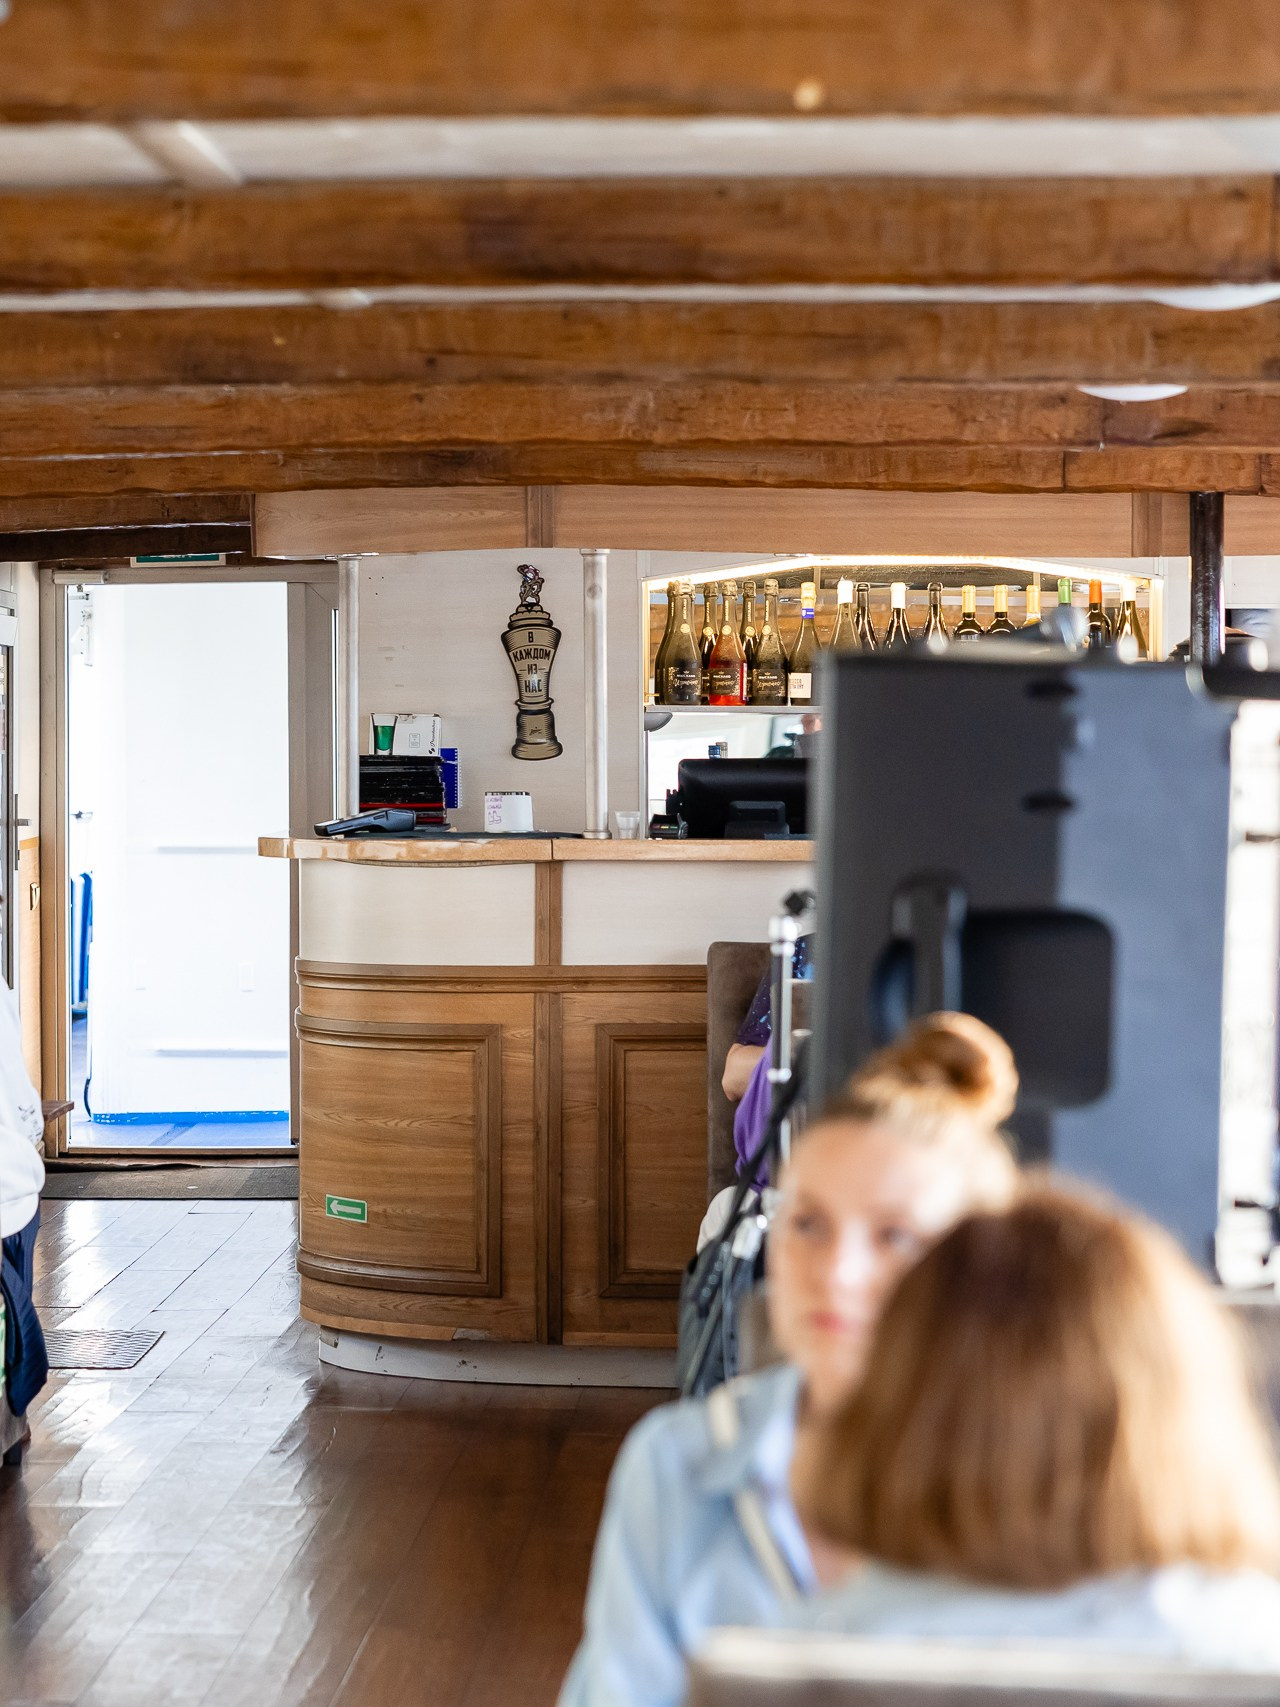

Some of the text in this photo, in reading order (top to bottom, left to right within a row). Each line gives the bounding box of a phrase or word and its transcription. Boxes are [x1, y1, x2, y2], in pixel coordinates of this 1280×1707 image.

[528, 631, 534, 643] В
[512, 648, 551, 662] КАЖДОМ
[527, 664, 538, 675] ИЗ
[524, 680, 542, 693] НАС
